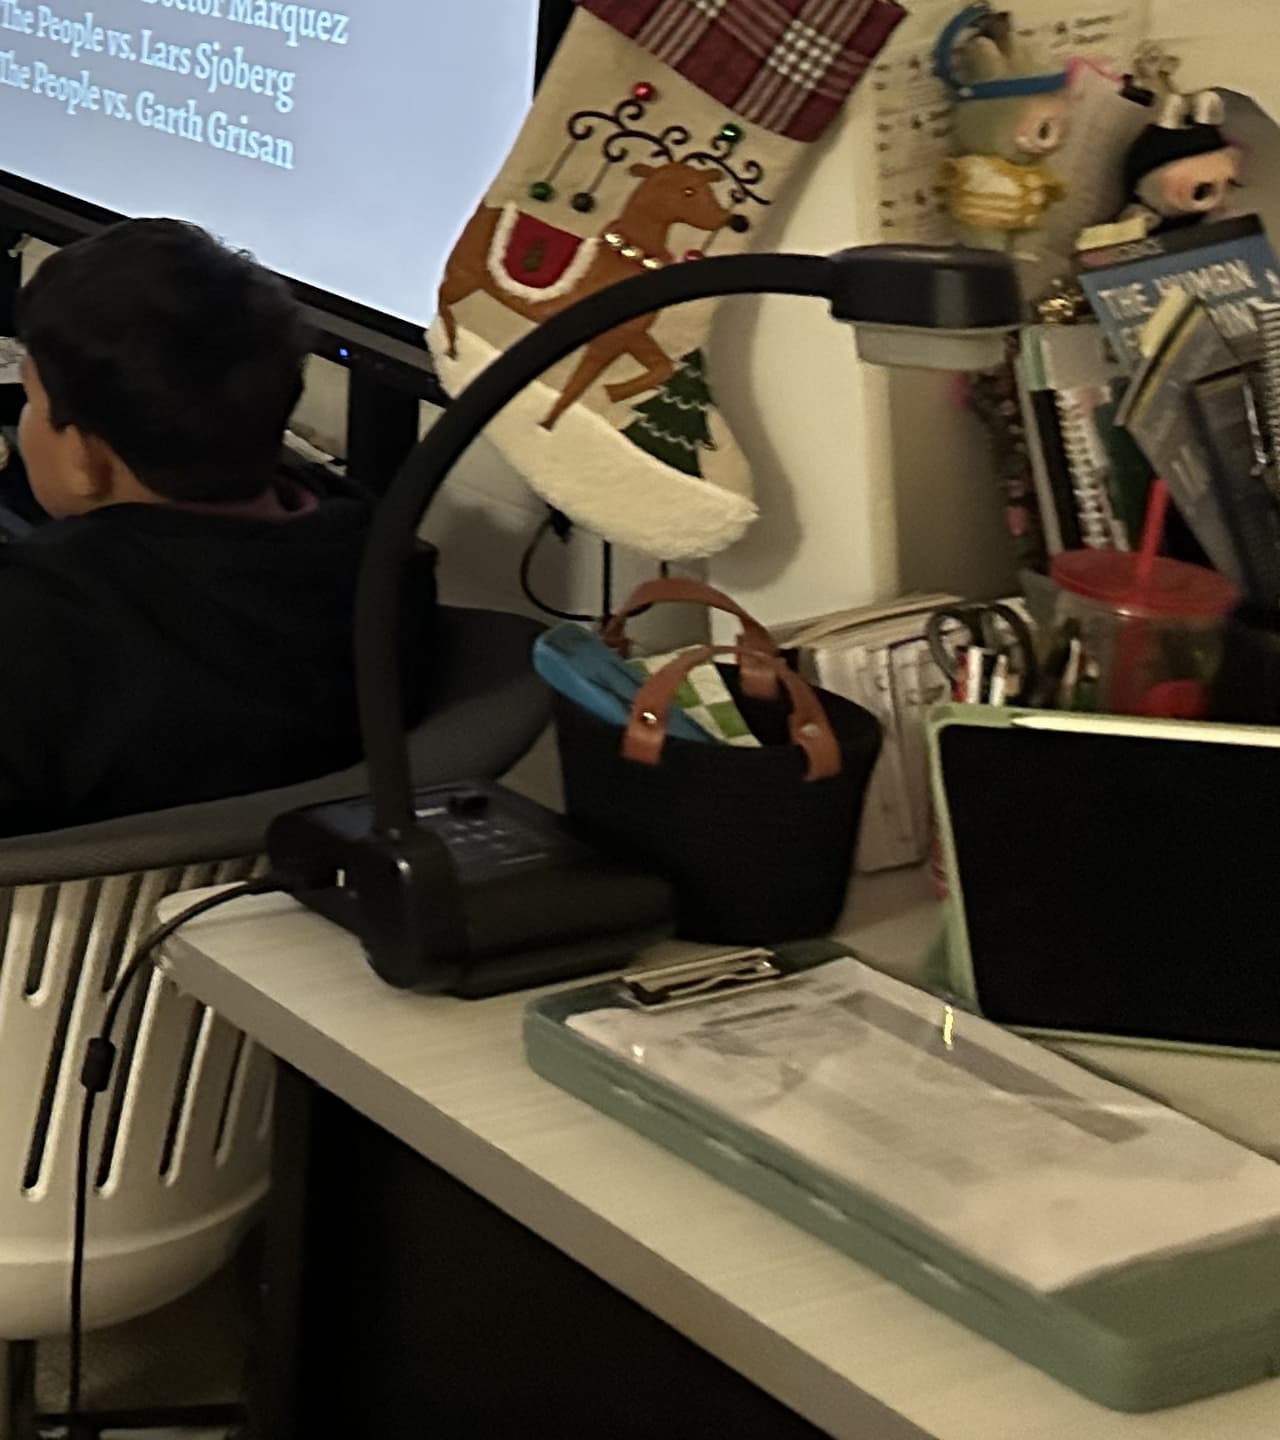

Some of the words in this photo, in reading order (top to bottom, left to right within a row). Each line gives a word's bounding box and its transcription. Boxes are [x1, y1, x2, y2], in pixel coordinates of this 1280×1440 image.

[37, 4, 105, 58] People
[106, 32, 137, 62] vs.
[139, 28, 192, 76] Lars
[194, 43, 296, 113] Sjoberg
[33, 61, 99, 116] People
[102, 91, 132, 121] vs.
[135, 90, 204, 144] Garth
[206, 110, 295, 170] Grisan
